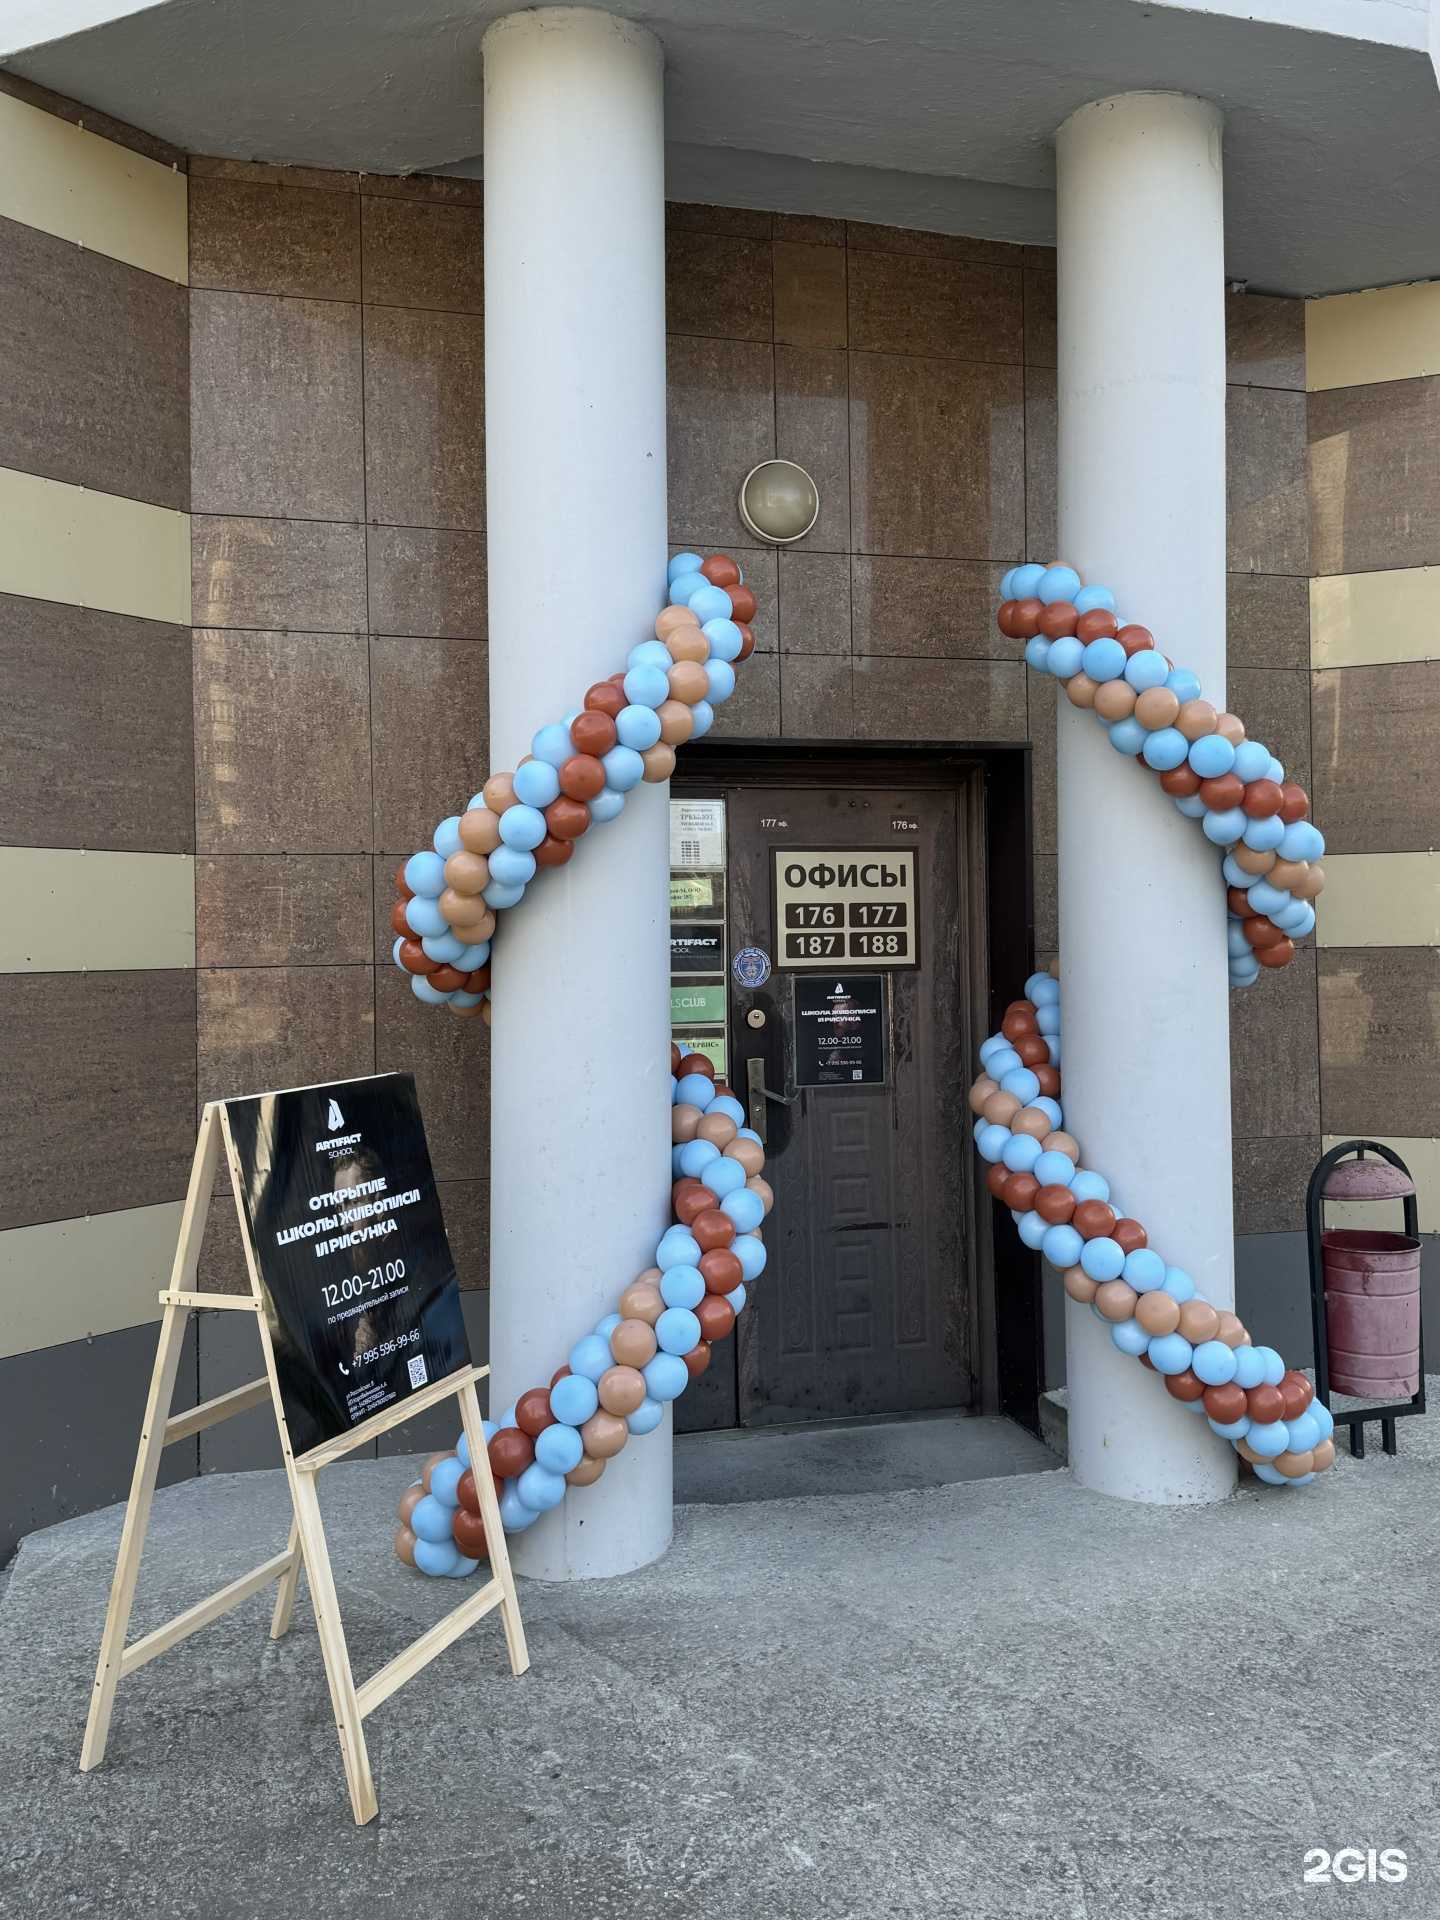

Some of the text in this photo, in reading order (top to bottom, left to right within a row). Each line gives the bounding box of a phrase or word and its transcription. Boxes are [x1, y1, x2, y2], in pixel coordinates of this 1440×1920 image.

[760, 818, 777, 828] 177
[892, 820, 908, 830] 176
[784, 863, 907, 889] ОФИСЫ
[795, 905, 898, 926] 176 177
[671, 938, 718, 946] RTIFACT
[796, 935, 899, 955] 187 188
[315, 1133, 362, 1152] ARTIFACT
[328, 1147, 355, 1159] SCHOOL
[309, 1177, 388, 1211] ОТКРЫТИЕ
[276, 1189, 421, 1246] ШКОЛЫ ЖИВОПИСИ
[315, 1218, 398, 1257] И РИСУНКА
[328, 1285, 409, 1325] по предварительной записи
[352, 1328, 420, 1368] +7 995 596-99-66
